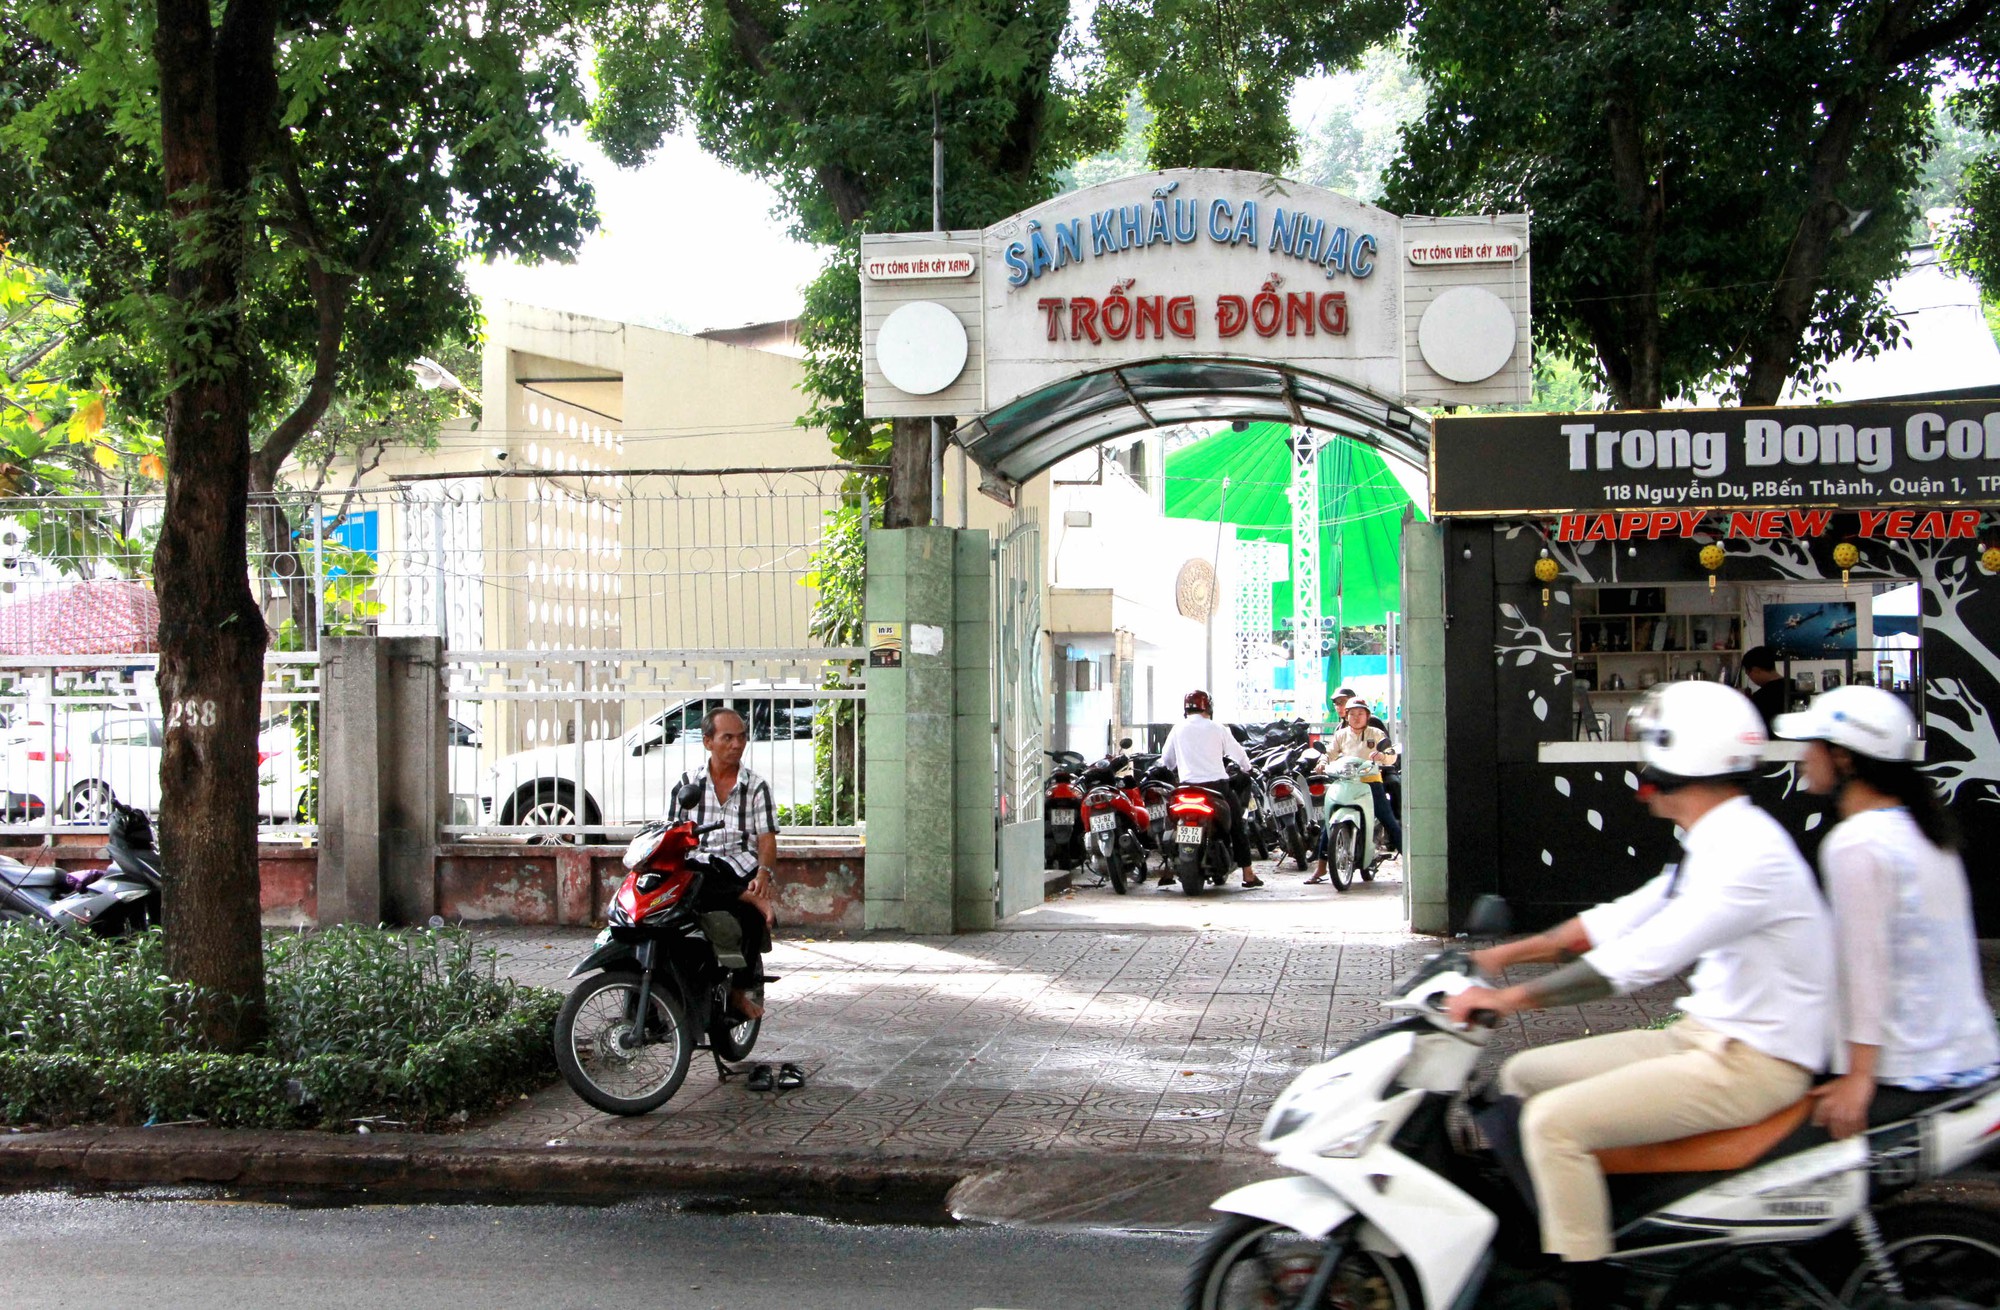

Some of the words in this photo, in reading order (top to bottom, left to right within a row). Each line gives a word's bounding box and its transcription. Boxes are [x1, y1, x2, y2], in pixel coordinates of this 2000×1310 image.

[1004, 218, 1083, 287] SÂN
[1089, 181, 1197, 256] KHẤU
[1207, 198, 1258, 249] CA
[1268, 207, 1378, 280] NHẠC
[870, 263, 885, 275] CTY
[887, 260, 909, 274] CÔNG
[911, 259, 929, 273] VIÊN
[931, 258, 946, 273] CÂY
[948, 259, 970, 272] XANH
[1412, 248, 1428, 260] CTY
[1429, 245, 1452, 259] CÔNG
[1454, 244, 1473, 258] VIÊN
[1476, 243, 1492, 258] CÂY
[1038, 278, 1196, 345] TRỐNG
[1560, 423, 1727, 478] Trong
[1743, 419, 1893, 474] Đong
[1603, 484, 1631, 500] 118
[1635, 479, 1713, 504] Nguyễn
[1717, 482, 1749, 501] Du,
[1889, 476, 1945, 498] Quận
[1951, 477, 1967, 495] 1,
[1557, 509, 1707, 542] HAPPY
[1728, 509, 1833, 539] NEW
[1858, 509, 1982, 540] YEAR
[169, 699, 217, 728] 298
